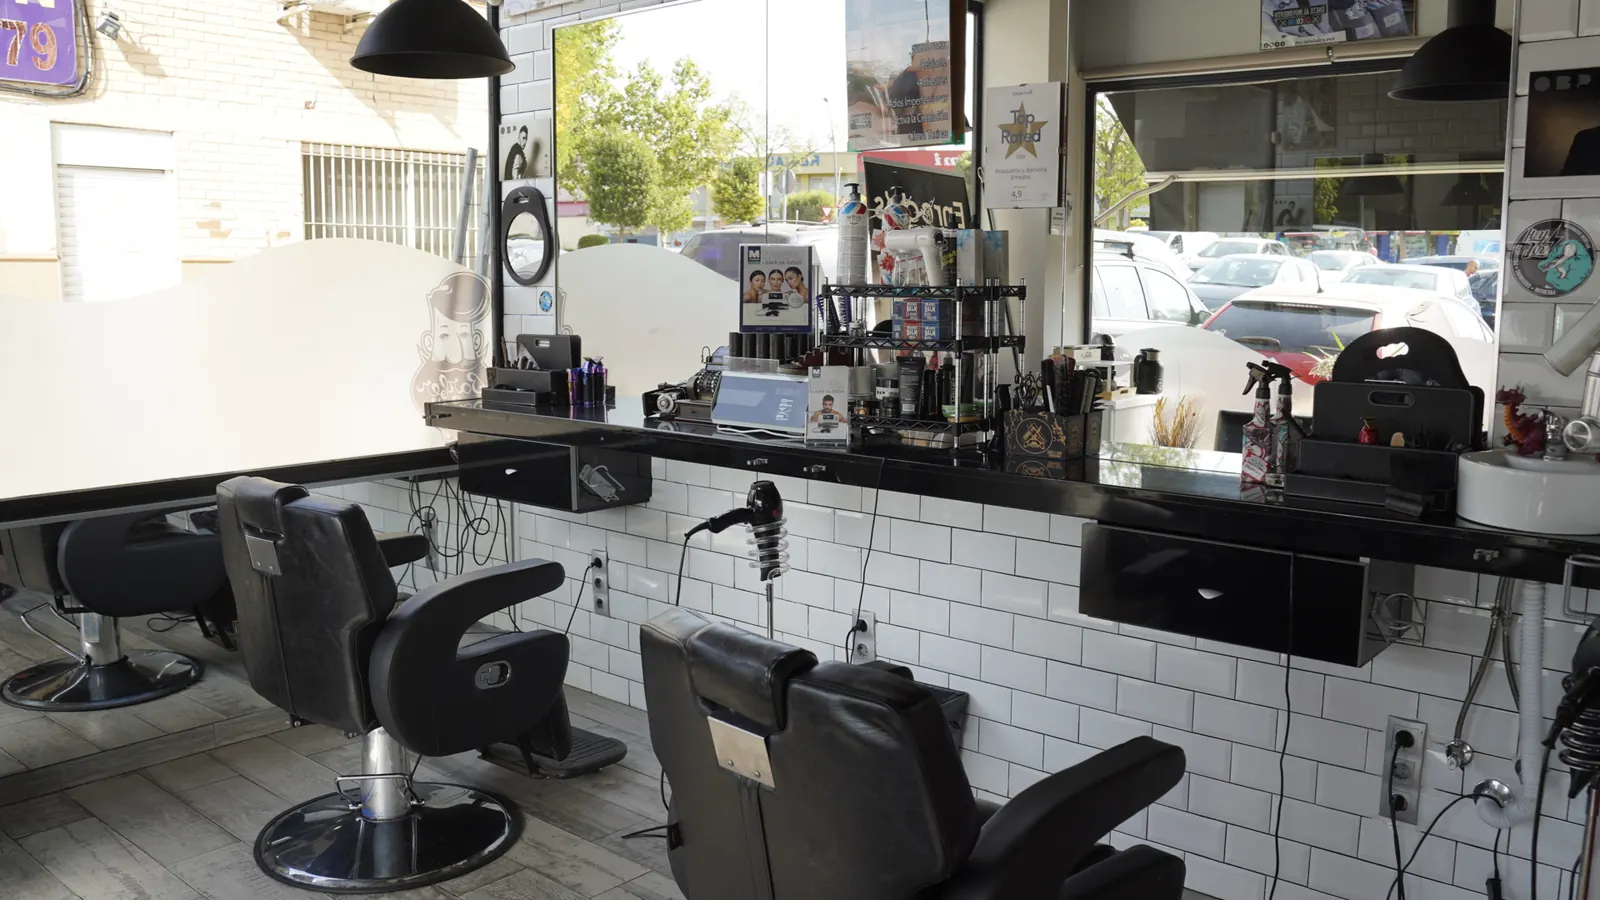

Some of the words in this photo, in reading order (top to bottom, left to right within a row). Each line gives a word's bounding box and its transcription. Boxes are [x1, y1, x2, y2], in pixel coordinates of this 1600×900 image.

[0, 18, 57, 71] 79
[1010, 109, 1035, 128] Top
[1001, 129, 1041, 144] Rated
[1011, 190, 1023, 200] 4,9
